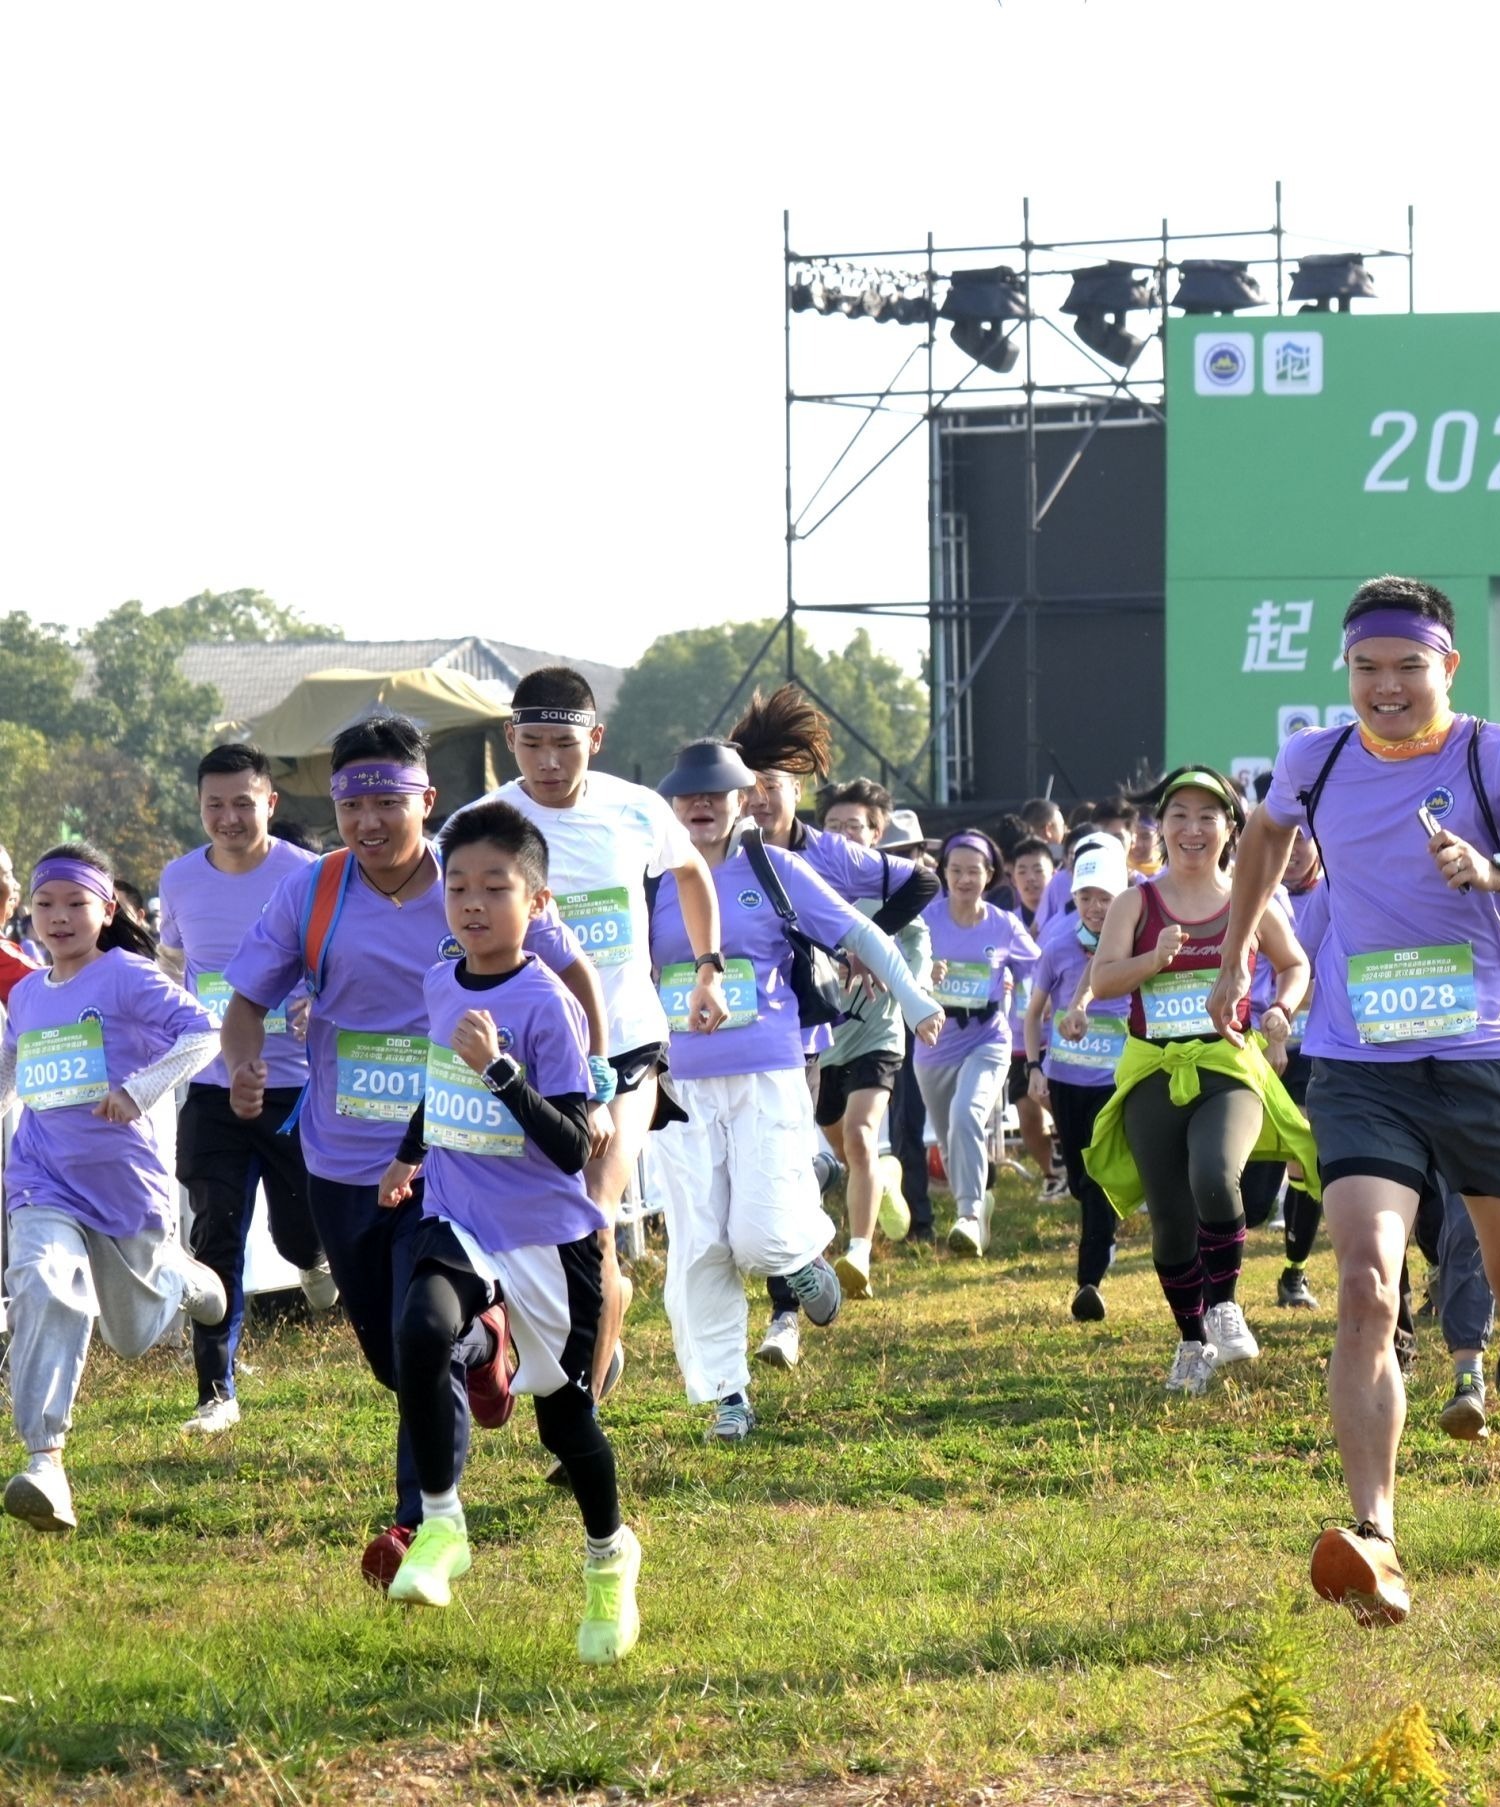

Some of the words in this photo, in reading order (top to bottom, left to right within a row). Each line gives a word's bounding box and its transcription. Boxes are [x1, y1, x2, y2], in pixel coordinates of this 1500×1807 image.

[1241, 599, 1346, 673] 起
[540, 710, 591, 726] saucony
[1363, 983, 1457, 1016] 20028
[24, 1056, 89, 1088] 20032
[352, 1067, 424, 1097] 2001
[425, 1086, 502, 1128] 20005
